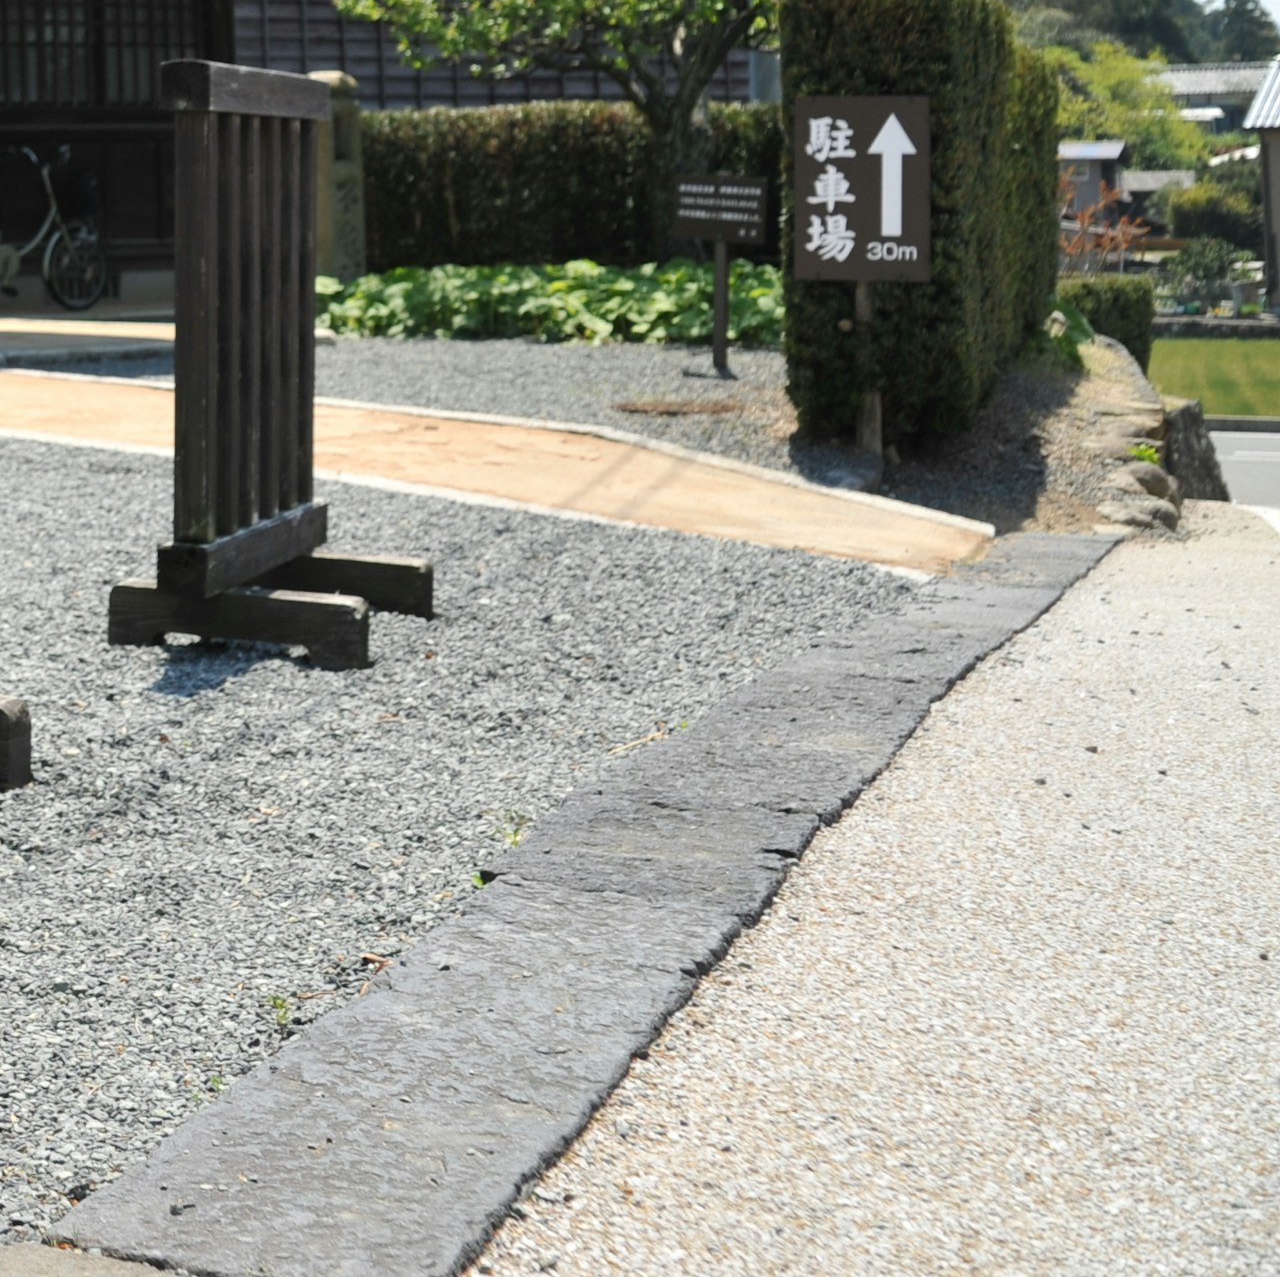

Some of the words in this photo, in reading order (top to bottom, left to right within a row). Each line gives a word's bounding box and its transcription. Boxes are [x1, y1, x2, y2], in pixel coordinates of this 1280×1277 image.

[804, 116, 857, 264] 駐車場
[866, 242, 918, 262] 30m
